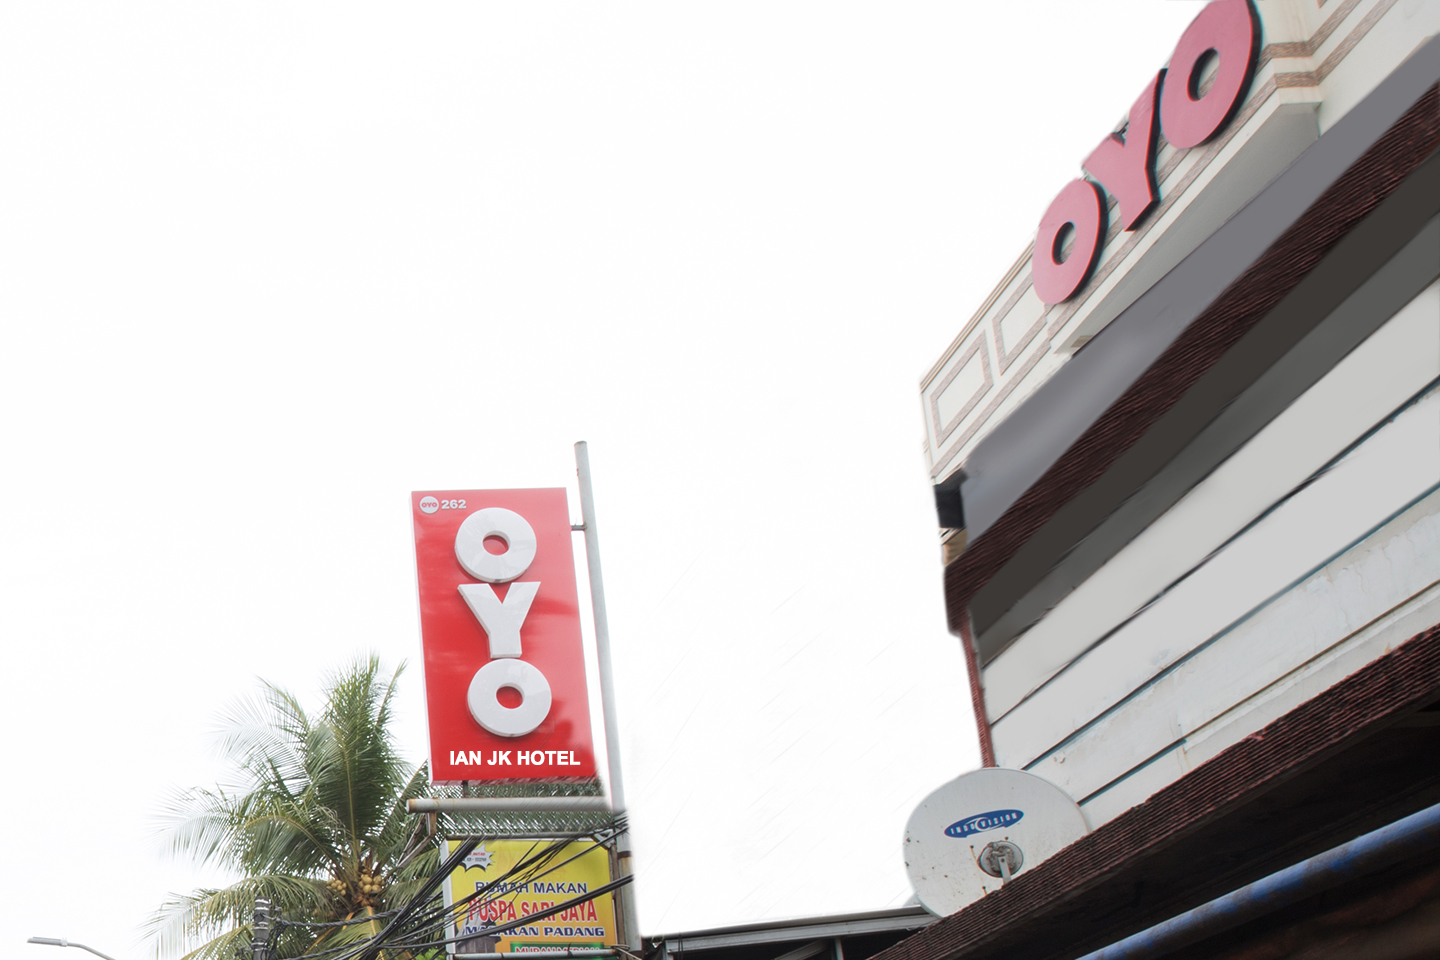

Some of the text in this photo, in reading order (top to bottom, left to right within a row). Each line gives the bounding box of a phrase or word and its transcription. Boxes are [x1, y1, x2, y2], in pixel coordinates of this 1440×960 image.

[1032, 0, 1263, 305] OYO
[441, 499, 467, 510] 262
[454, 507, 552, 738] OYO
[450, 750, 581, 766] IAN JK HOTEL
[533, 882, 587, 894] MAKAN
[468, 898, 517, 922] PUSPA
[560, 899, 598, 922] JAYA
[544, 927, 605, 937] PADANG
